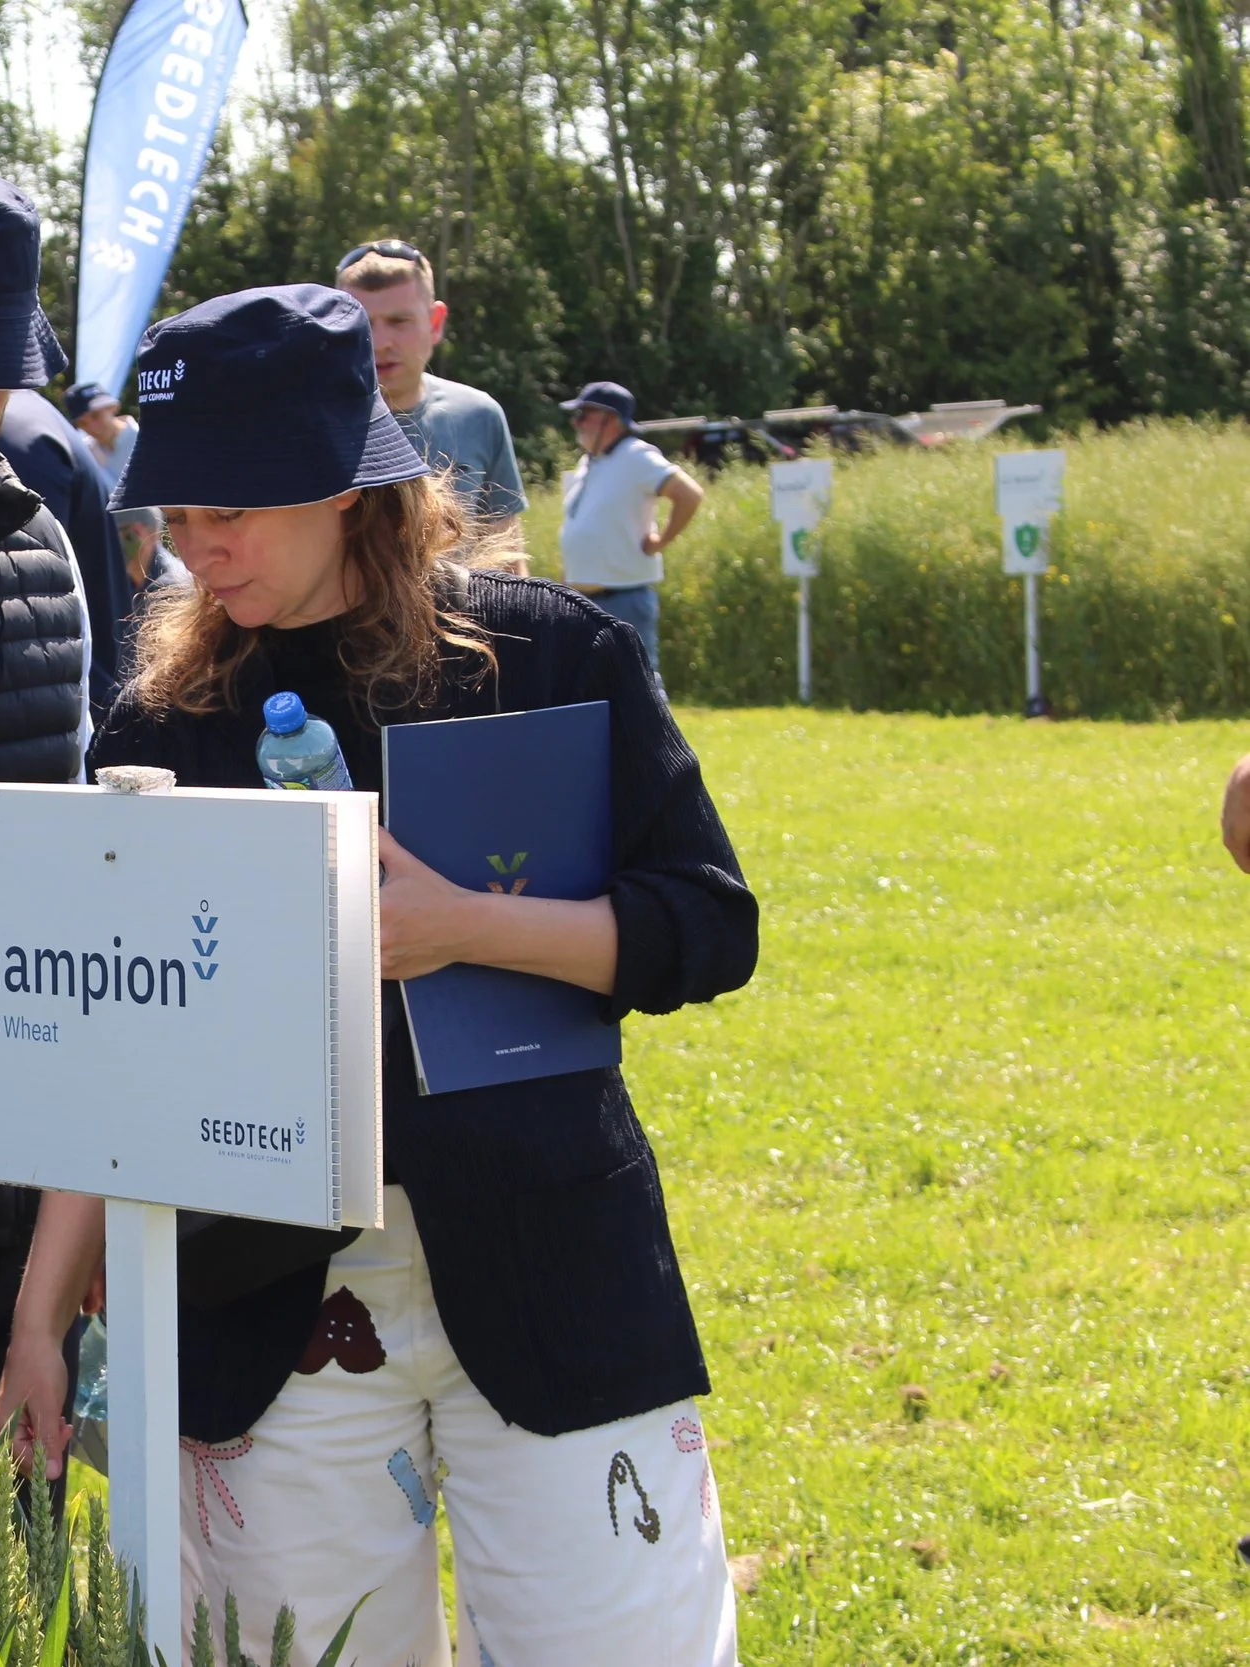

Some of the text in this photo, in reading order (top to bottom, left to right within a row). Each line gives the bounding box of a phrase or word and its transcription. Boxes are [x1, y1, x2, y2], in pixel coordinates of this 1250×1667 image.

[138, 369, 171, 391] TECH
[149, 392, 174, 401] COMPANY
[4, 1015, 59, 1043] Wheat
[201, 1117, 292, 1153] SEEDTECH
